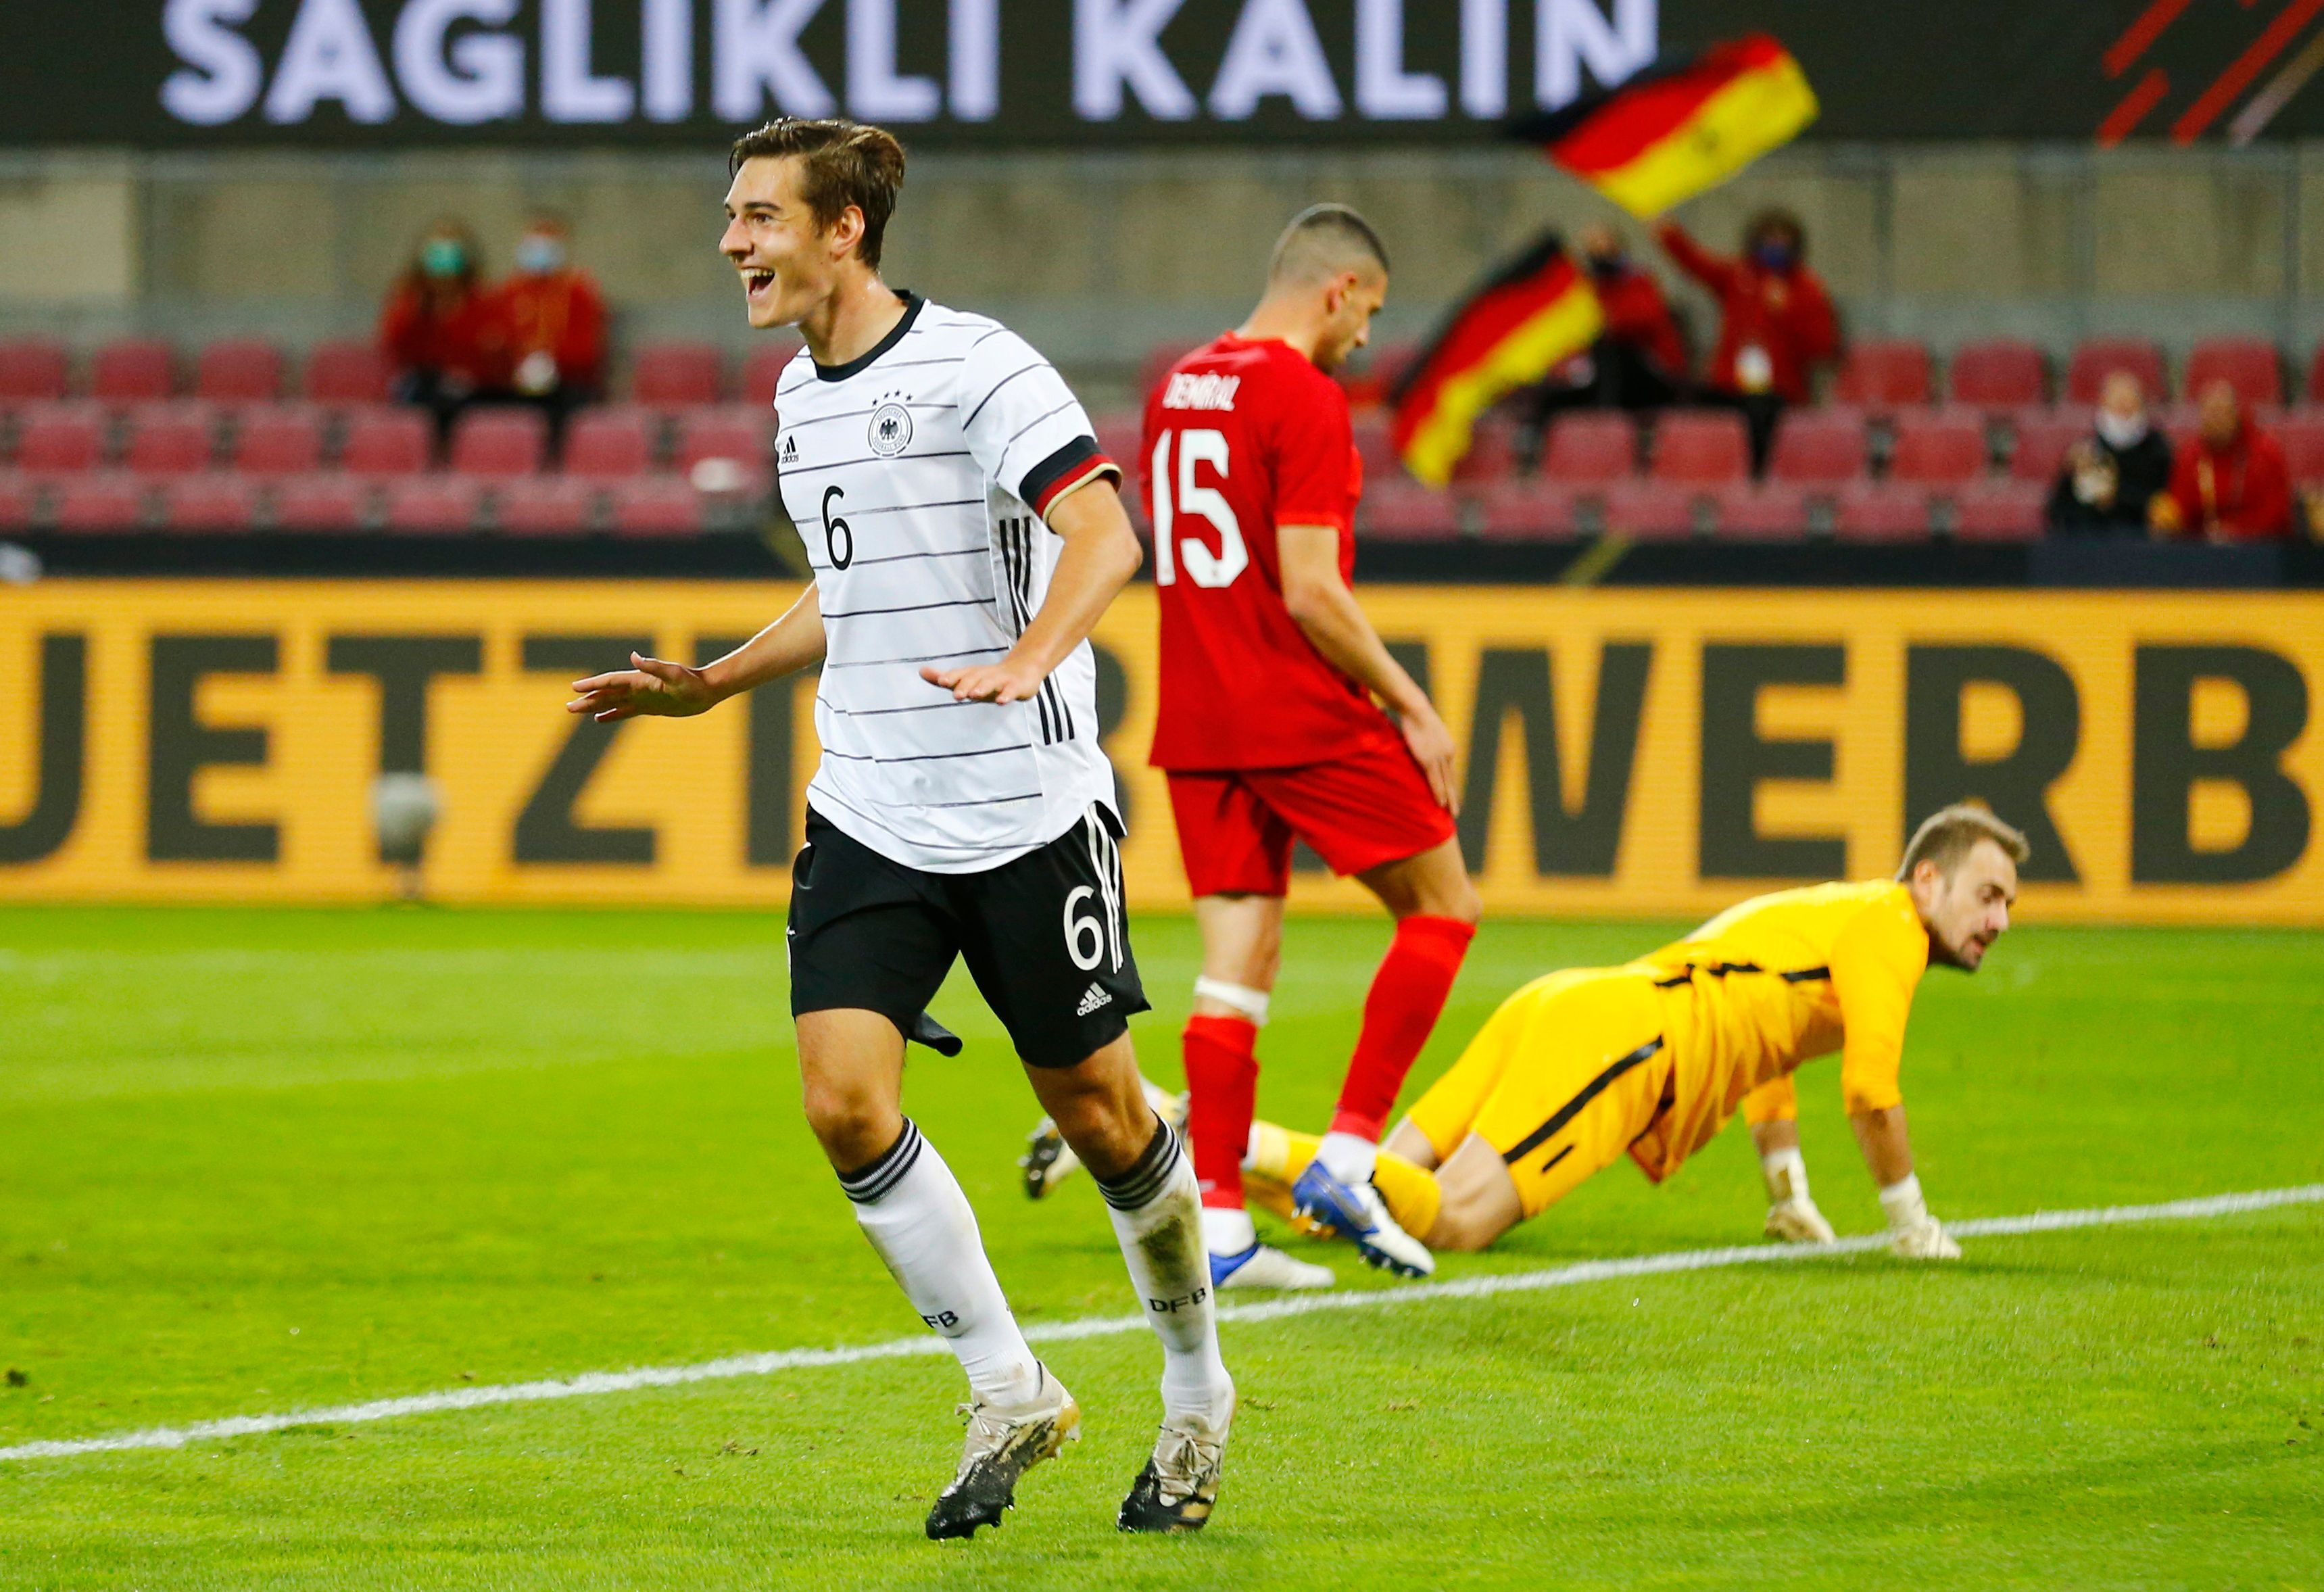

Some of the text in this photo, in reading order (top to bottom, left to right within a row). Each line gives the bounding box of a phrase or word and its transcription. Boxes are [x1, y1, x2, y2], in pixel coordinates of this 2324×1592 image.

[1072, 0, 1660, 122] KALIN
[822, 485, 853, 571] 6
[1152, 428, 1249, 588] 15
[1063, 885, 1105, 971] 6
[1076, 994, 1113, 1017] adidas
[1149, 1287, 1207, 1313] DFB
